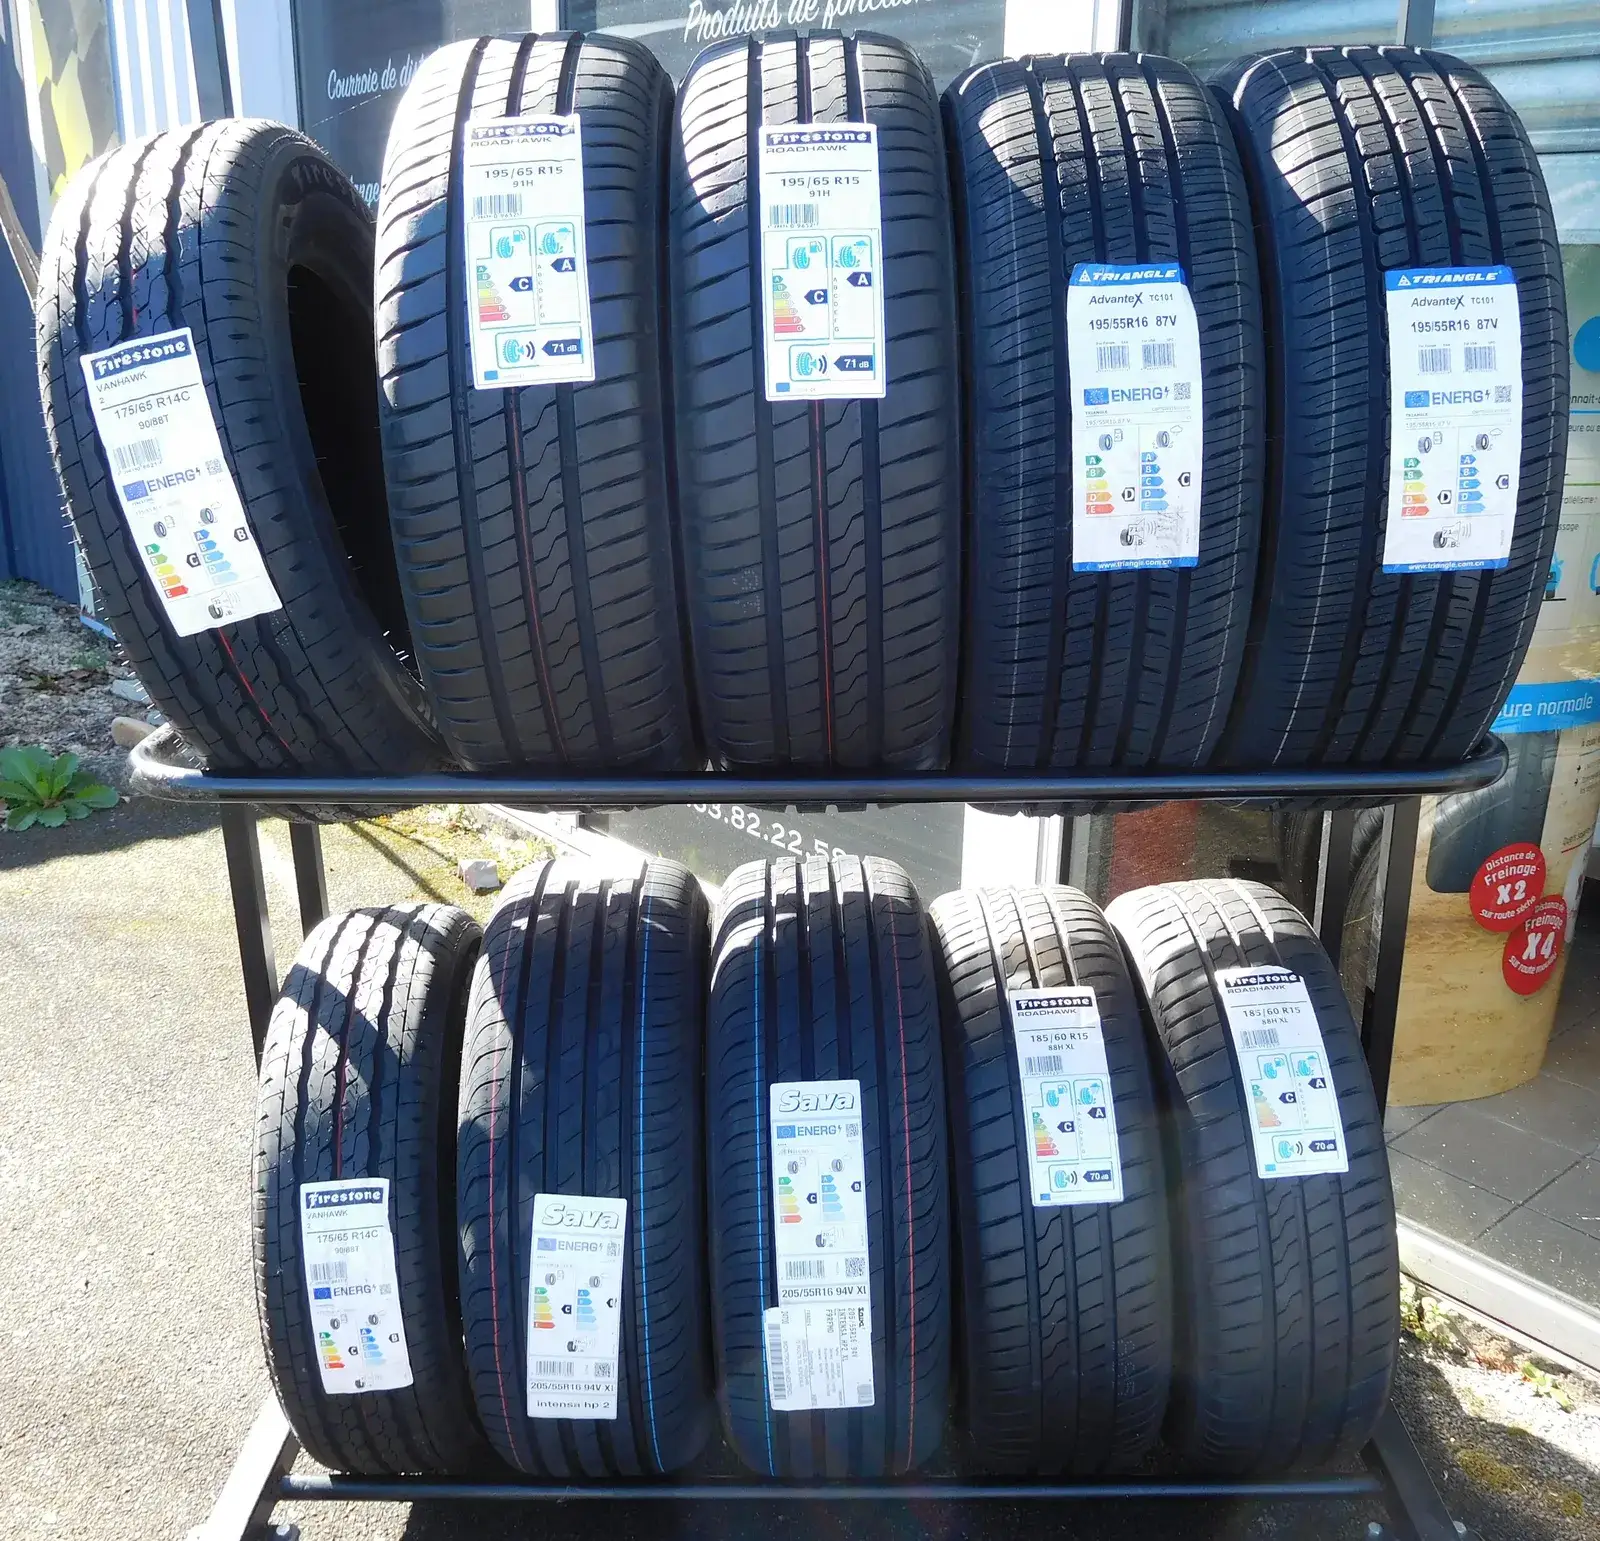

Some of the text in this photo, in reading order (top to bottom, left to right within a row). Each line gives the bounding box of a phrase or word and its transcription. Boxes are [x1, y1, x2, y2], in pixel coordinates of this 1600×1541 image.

[684, 0, 781, 43] Produits
[788, 0, 820, 25] de
[327, 67, 379, 100] Courroie
[381, 58, 397, 91] de
[474, 122, 575, 139] Firestone
[471, 137, 552, 148] ROADHAWK
[769, 132, 868, 145] Firestone
[766, 144, 847, 154] ROADHAWK
[485, 166, 563, 179] 195/65 R15
[513, 180, 534, 188] 91H
[780, 176, 860, 188] 195/65 R15
[809, 189, 831, 198] 91H
[561, 259, 573, 271] A
[857, 273, 869, 285] A
[1092, 269, 1178, 281] TRIANGLE
[1412, 272, 1499, 284] TRIANGLE
[518, 278, 530, 290] C
[813, 290, 825, 303] C
[1089, 292, 1174, 308] AdvanteX TC101
[1411, 295, 1465, 310] AdvanteX
[1089, 315, 1177, 331] 195/55R16 87V
[1411, 318, 1499, 333] 195/55R16 87V
[552, 343, 578, 353] 71 dB
[95, 340, 186, 376] Firestone
[844, 359, 870, 369] 71 dB
[96, 370, 147, 393] VANHAWK
[1111, 387, 1163, 402] ENERG
[1431, 390, 1484, 405] ENERG
[115, 391, 191, 420] 175/65 R14C
[138, 414, 169, 430] 90/88T
[147, 470, 196, 492] ENERG
[1501, 692, 1593, 718] ure normale
[1485, 850, 1536, 871] Distance de
[1484, 864, 1537, 886] Freinage
[1479, 908, 1494, 919] sur
[1494, 909, 1515, 920] route
[1525, 912, 1563, 932] Freinage
[1508, 955, 1520, 968] sur
[1226, 974, 1298, 987] Firestone
[1227, 984, 1286, 994] ROADHAWK
[1019, 997, 1091, 1010] Firestone
[1017, 1008, 1077, 1017] ROADHAWK
[1243, 1006, 1301, 1018] 185/60 R15
[1261, 1018, 1277, 1026] 88H
[1030, 1032, 1089, 1043] 185/60 R15
[1315, 1079, 1325, 1088] A
[779, 1089, 855, 1112] Sava
[1285, 1093, 1295, 1102] C
[1095, 1108, 1104, 1117] A
[797, 1125, 837, 1137] ENERG
[1063, 1122, 1072, 1131] C
[1315, 1142, 1326, 1150] 70
[308, 1190, 381, 1209] Firestone
[306, 1210, 348, 1219] VANHAWK
[541, 1202, 619, 1230] Sava
[317, 1229, 379, 1243] 175/65 R14C
[558, 1241, 598, 1252] ENERG
[333, 1285, 372, 1297] ENERG
[782, 1287, 834, 1298] 205/55R16
[836, 1286, 854, 1296] 94V
[530, 1381, 582, 1391] 205/55R16
[583, 1383, 602, 1391] 94V
[537, 1400, 580, 1408] intensa
[584, 1401, 599, 1409] hp
